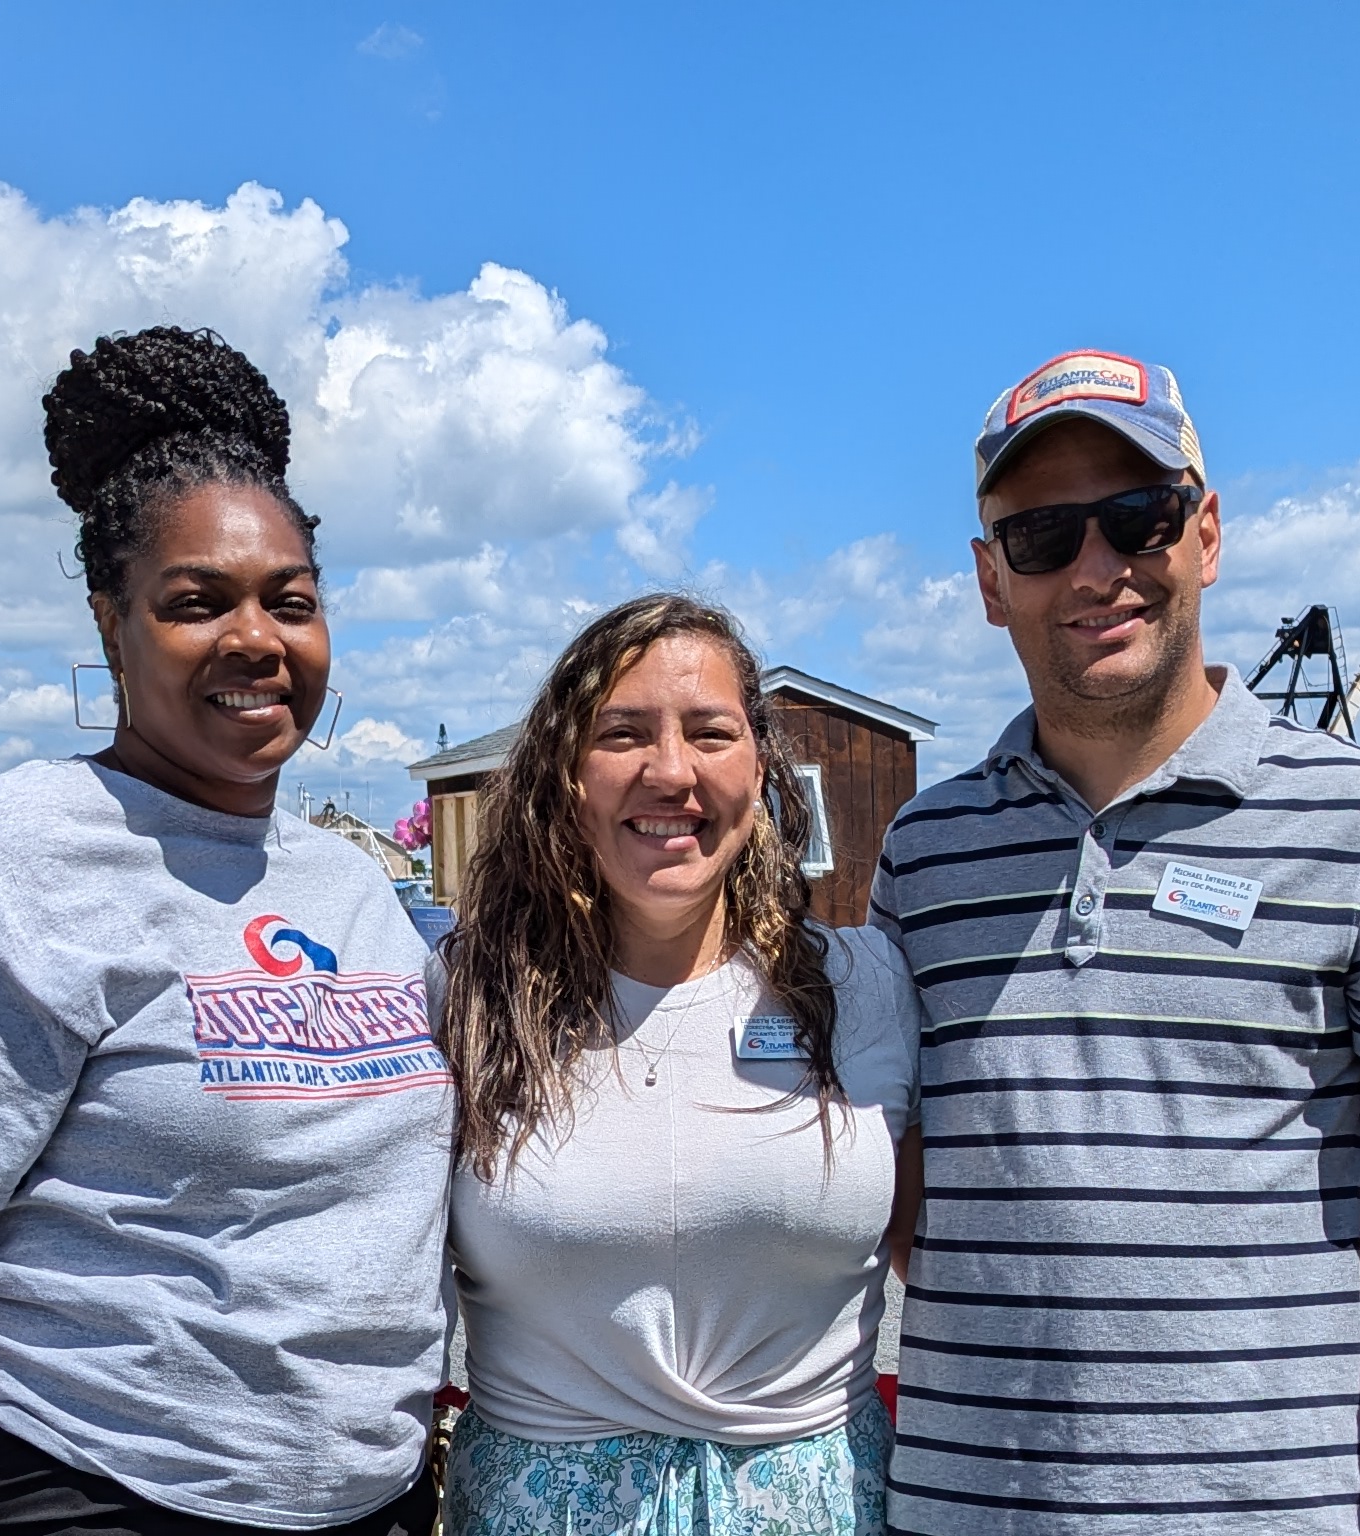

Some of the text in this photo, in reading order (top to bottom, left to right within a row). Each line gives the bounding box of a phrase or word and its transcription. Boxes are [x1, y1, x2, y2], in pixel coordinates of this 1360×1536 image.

[200, 1060, 291, 1084] ATLANTIC
[295, 1063, 330, 1086] CAPE
[330, 1054, 428, 1083] COMMUNITY
